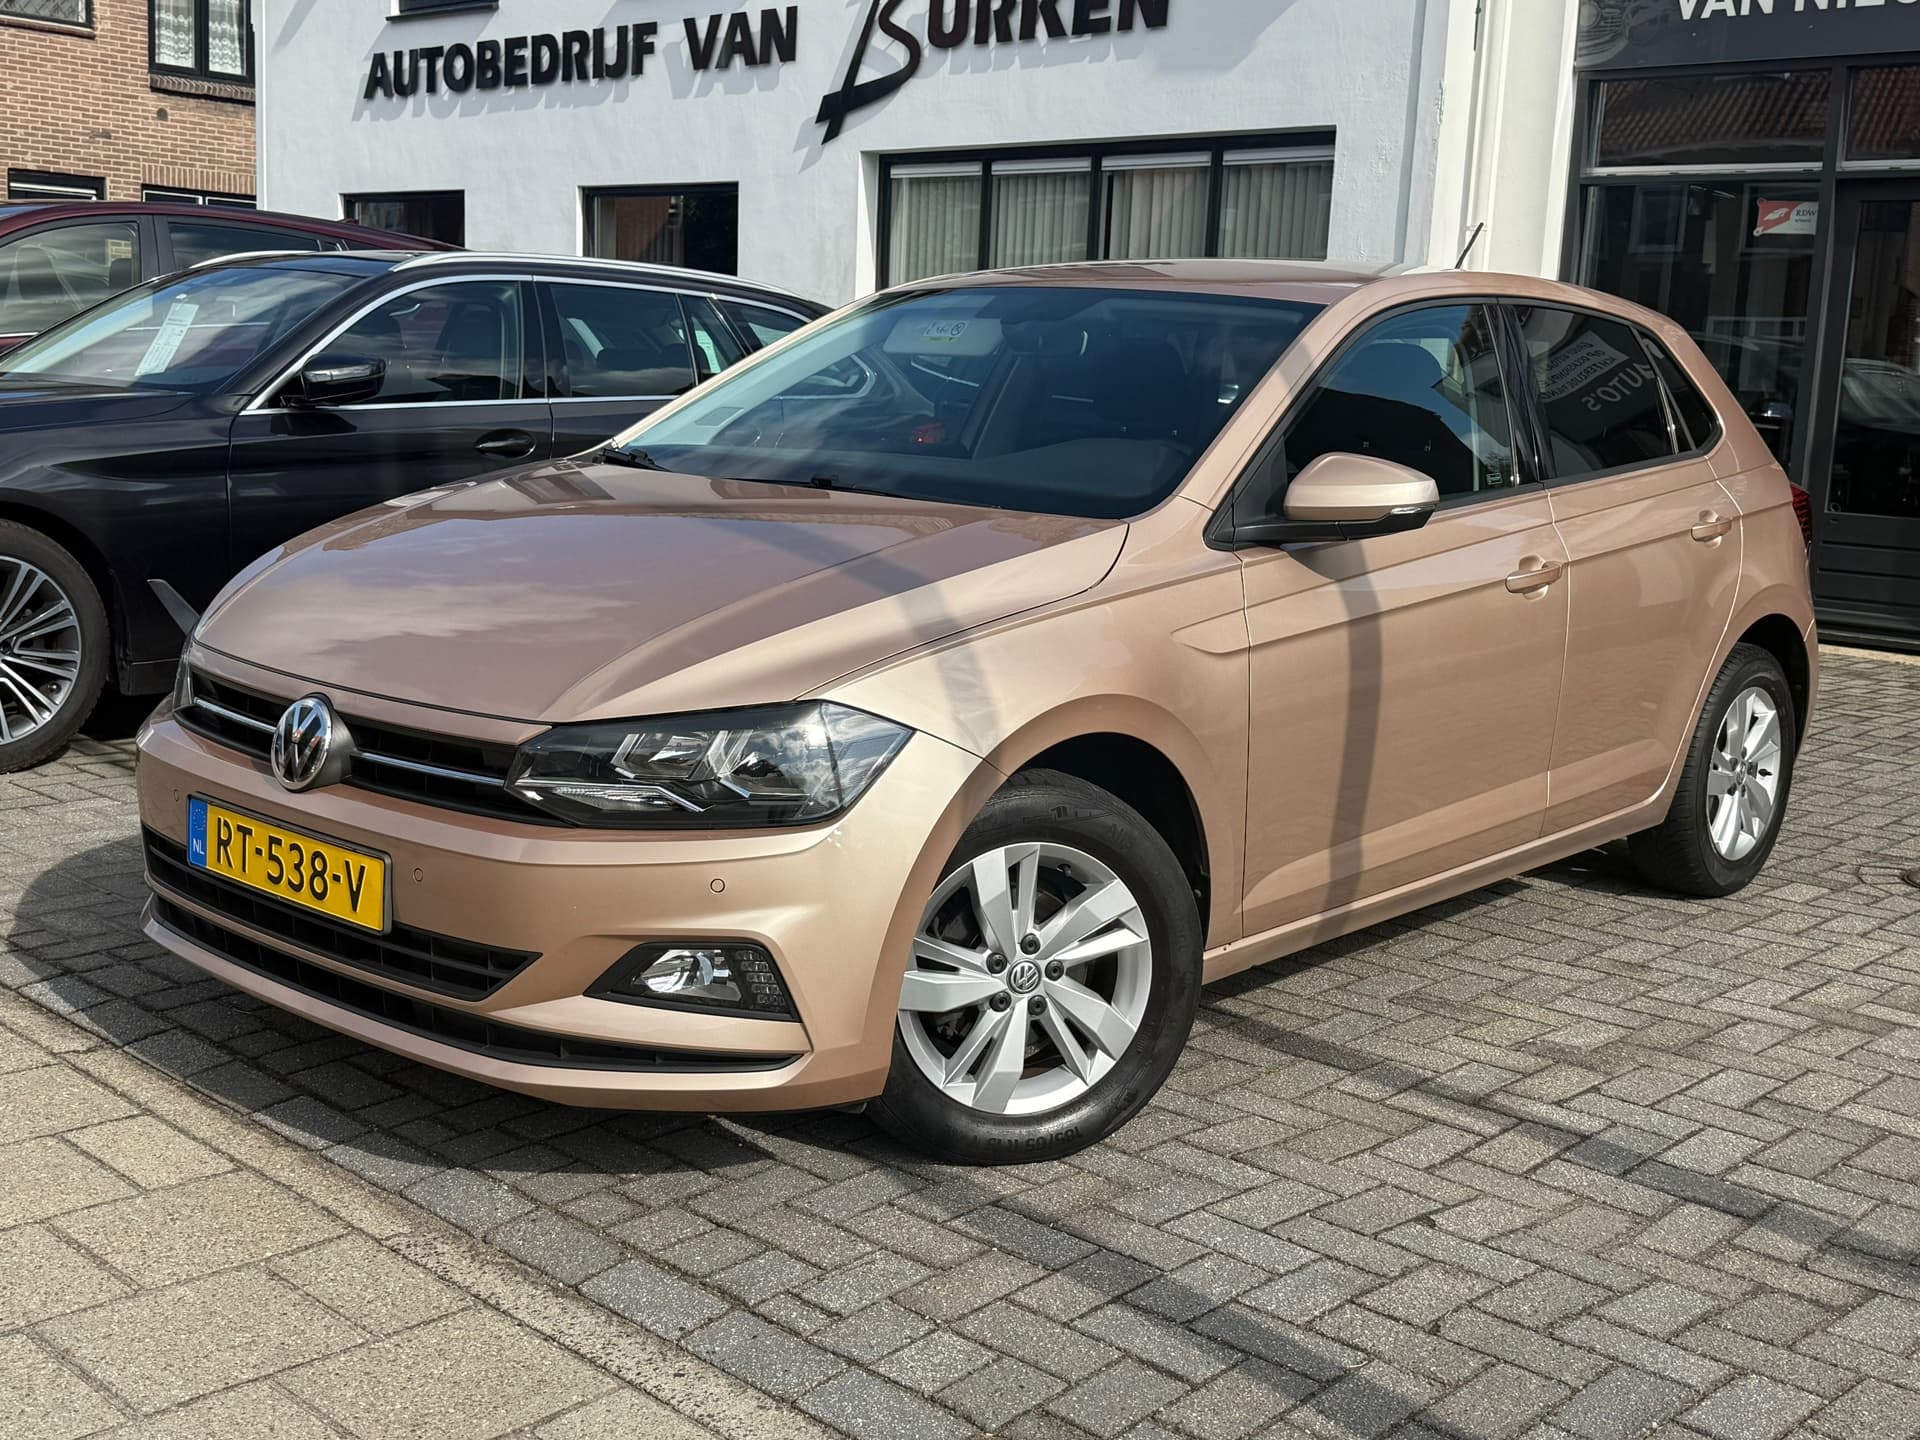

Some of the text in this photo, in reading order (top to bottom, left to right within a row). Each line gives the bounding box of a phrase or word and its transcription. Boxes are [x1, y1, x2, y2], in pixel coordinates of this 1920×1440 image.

[363, 21, 658, 99] AUTOBEDRIJF
[683, 5, 798, 70] VAN
[192, 838, 205, 855] NL
[216, 815, 367, 913] RT-538-V
